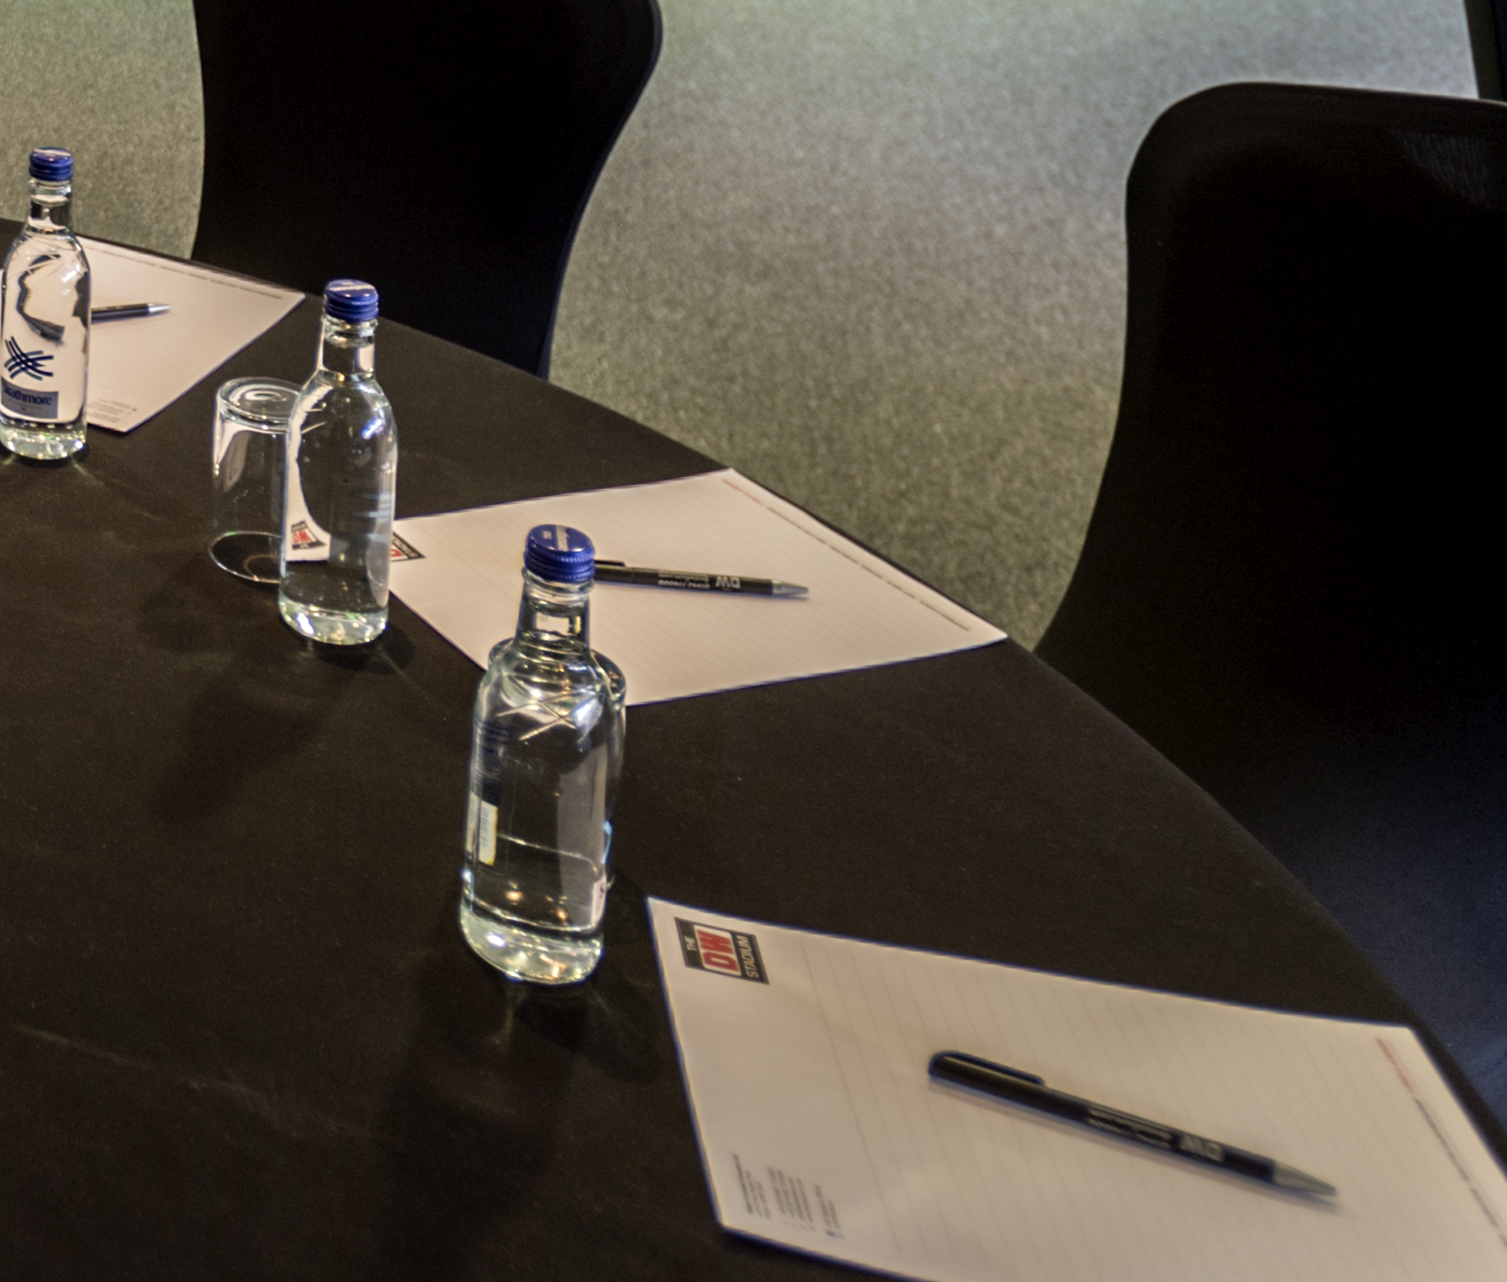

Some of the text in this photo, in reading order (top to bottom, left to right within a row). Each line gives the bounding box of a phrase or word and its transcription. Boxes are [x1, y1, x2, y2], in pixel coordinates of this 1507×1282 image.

[684, 935, 698, 952] THE
[696, 929, 740, 973] DW
[735, 934, 760, 979] STADIUM
